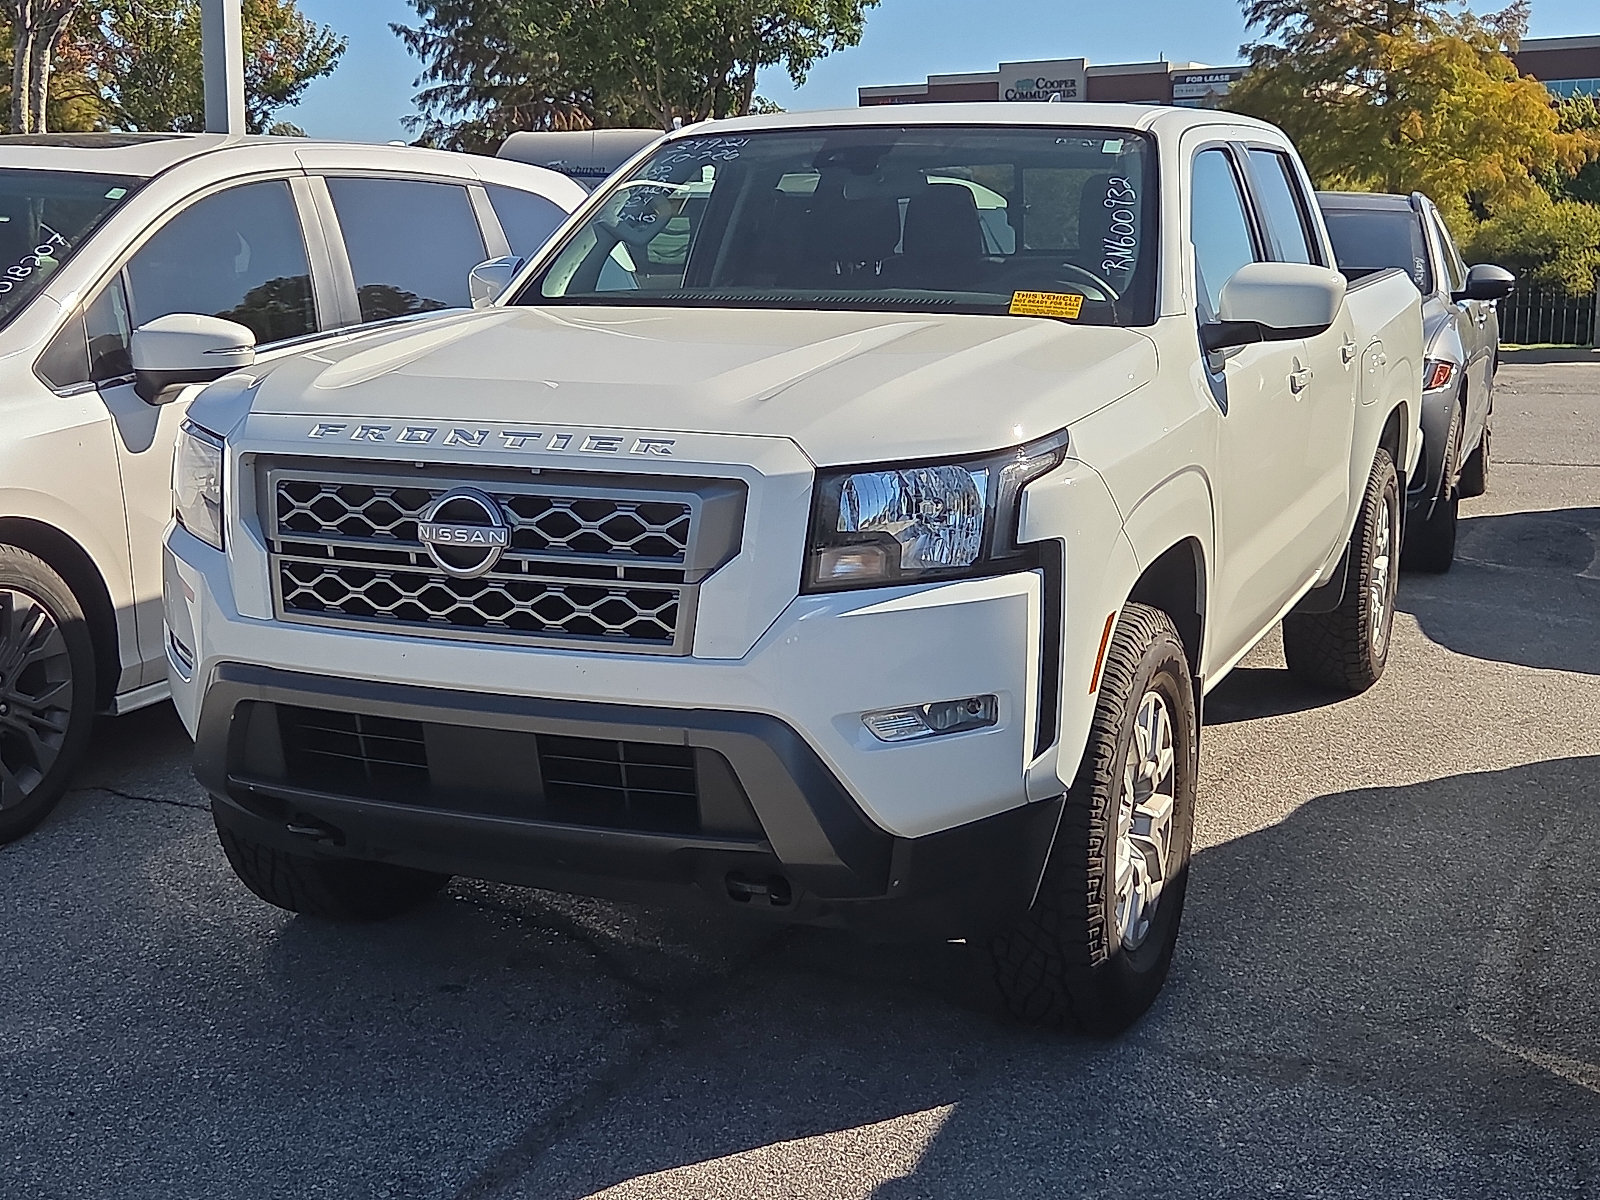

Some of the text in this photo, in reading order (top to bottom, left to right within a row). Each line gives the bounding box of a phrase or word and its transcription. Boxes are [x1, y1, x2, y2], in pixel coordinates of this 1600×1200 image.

[1204, 74, 1230, 82] LEASE
[1005, 89, 1077, 101] COMMUNTIES
[1041, 293, 1081, 302] VEHICLE
[308, 423, 676, 456] FRONTIER
[418, 524, 508, 545] NISSAN
